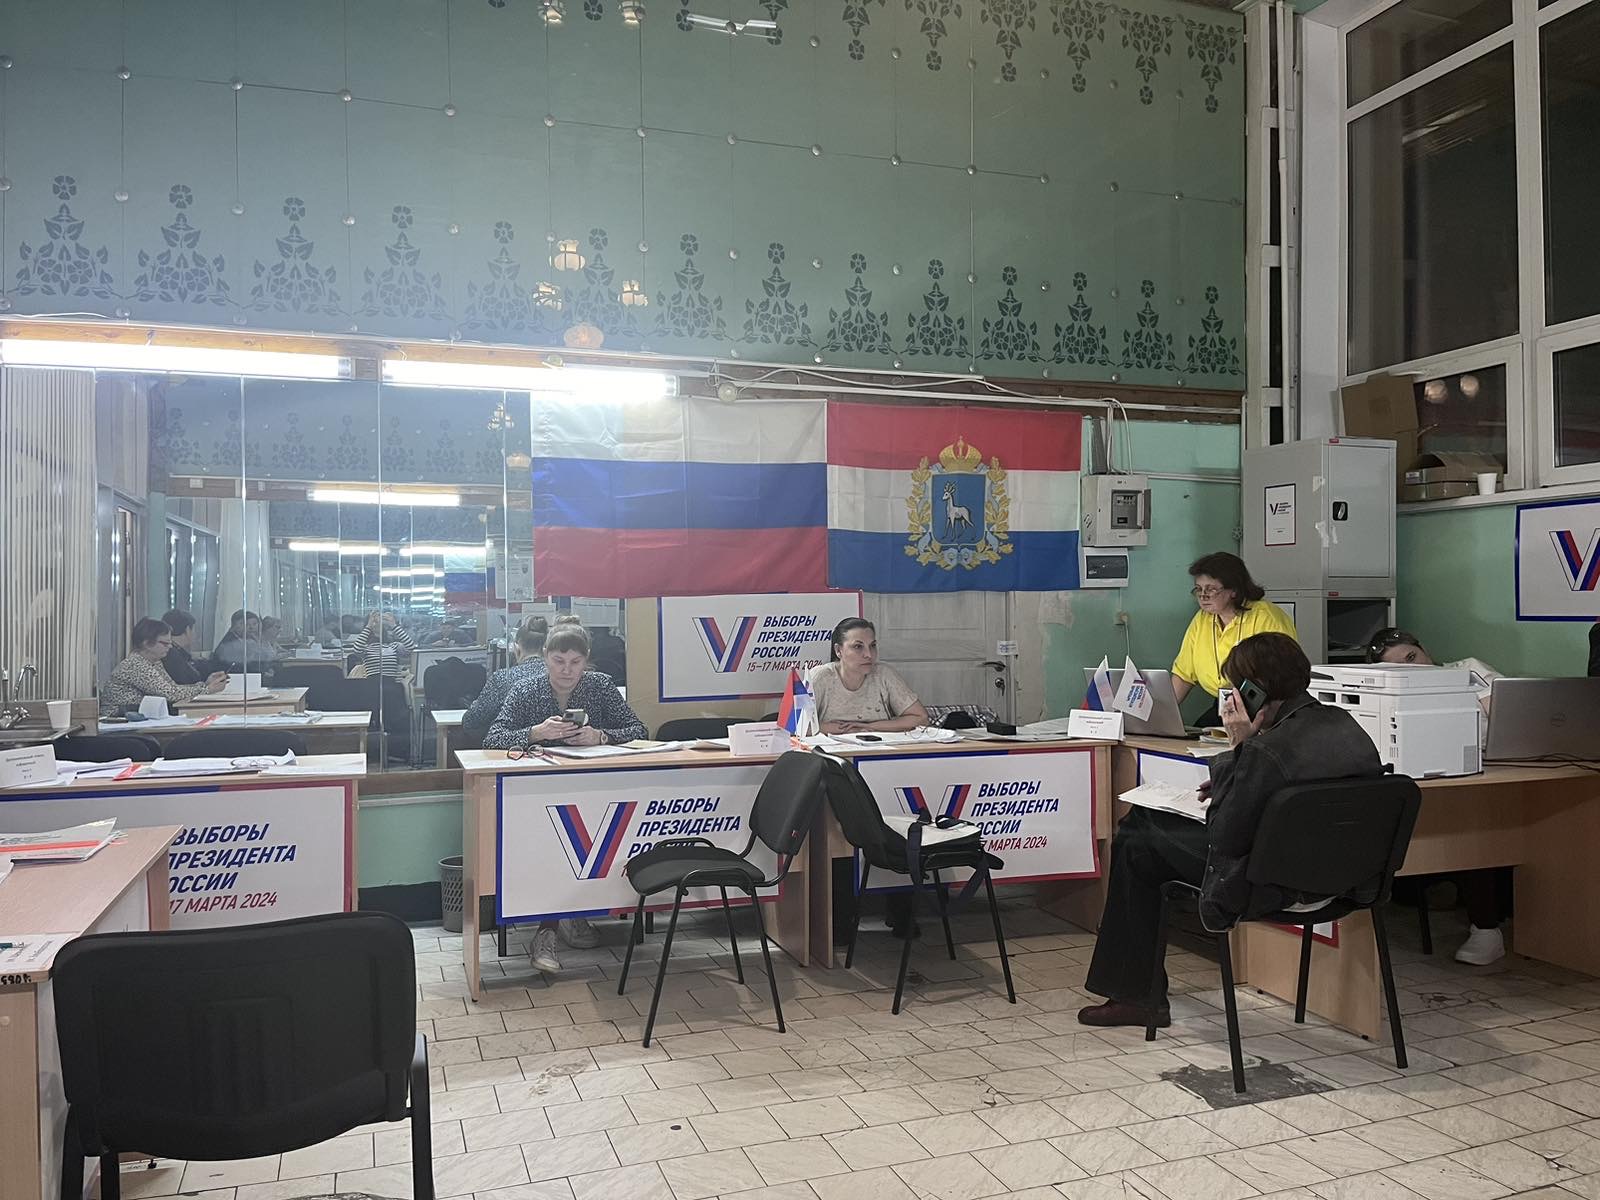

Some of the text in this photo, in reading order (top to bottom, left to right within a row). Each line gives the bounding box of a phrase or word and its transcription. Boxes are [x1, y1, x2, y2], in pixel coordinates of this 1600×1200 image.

[763, 616, 817, 627] ВЫБОРЫ
[758, 630, 833, 643] ПРЕЗИДЕНТА
[752, 646, 800, 658] РОССИИ
[771, 660, 800, 671] МАРТА
[978, 781, 1041, 798] ВЫБОРЫ
[645, 797, 720, 815] ВЫБОРЫ
[971, 799, 1059, 817] ПРЕЗИДЕНТА
[636, 816, 741, 837] ПРЕЗИДЕНТА
[978, 819, 1020, 835] ОССИИ
[988, 838, 1021, 851] МАРТА
[1024, 836, 1047, 849] 2024
[169, 872, 239, 894] ОССИИ
[184, 895, 238, 914] МАРТА
[240, 891, 279, 909] 2024
